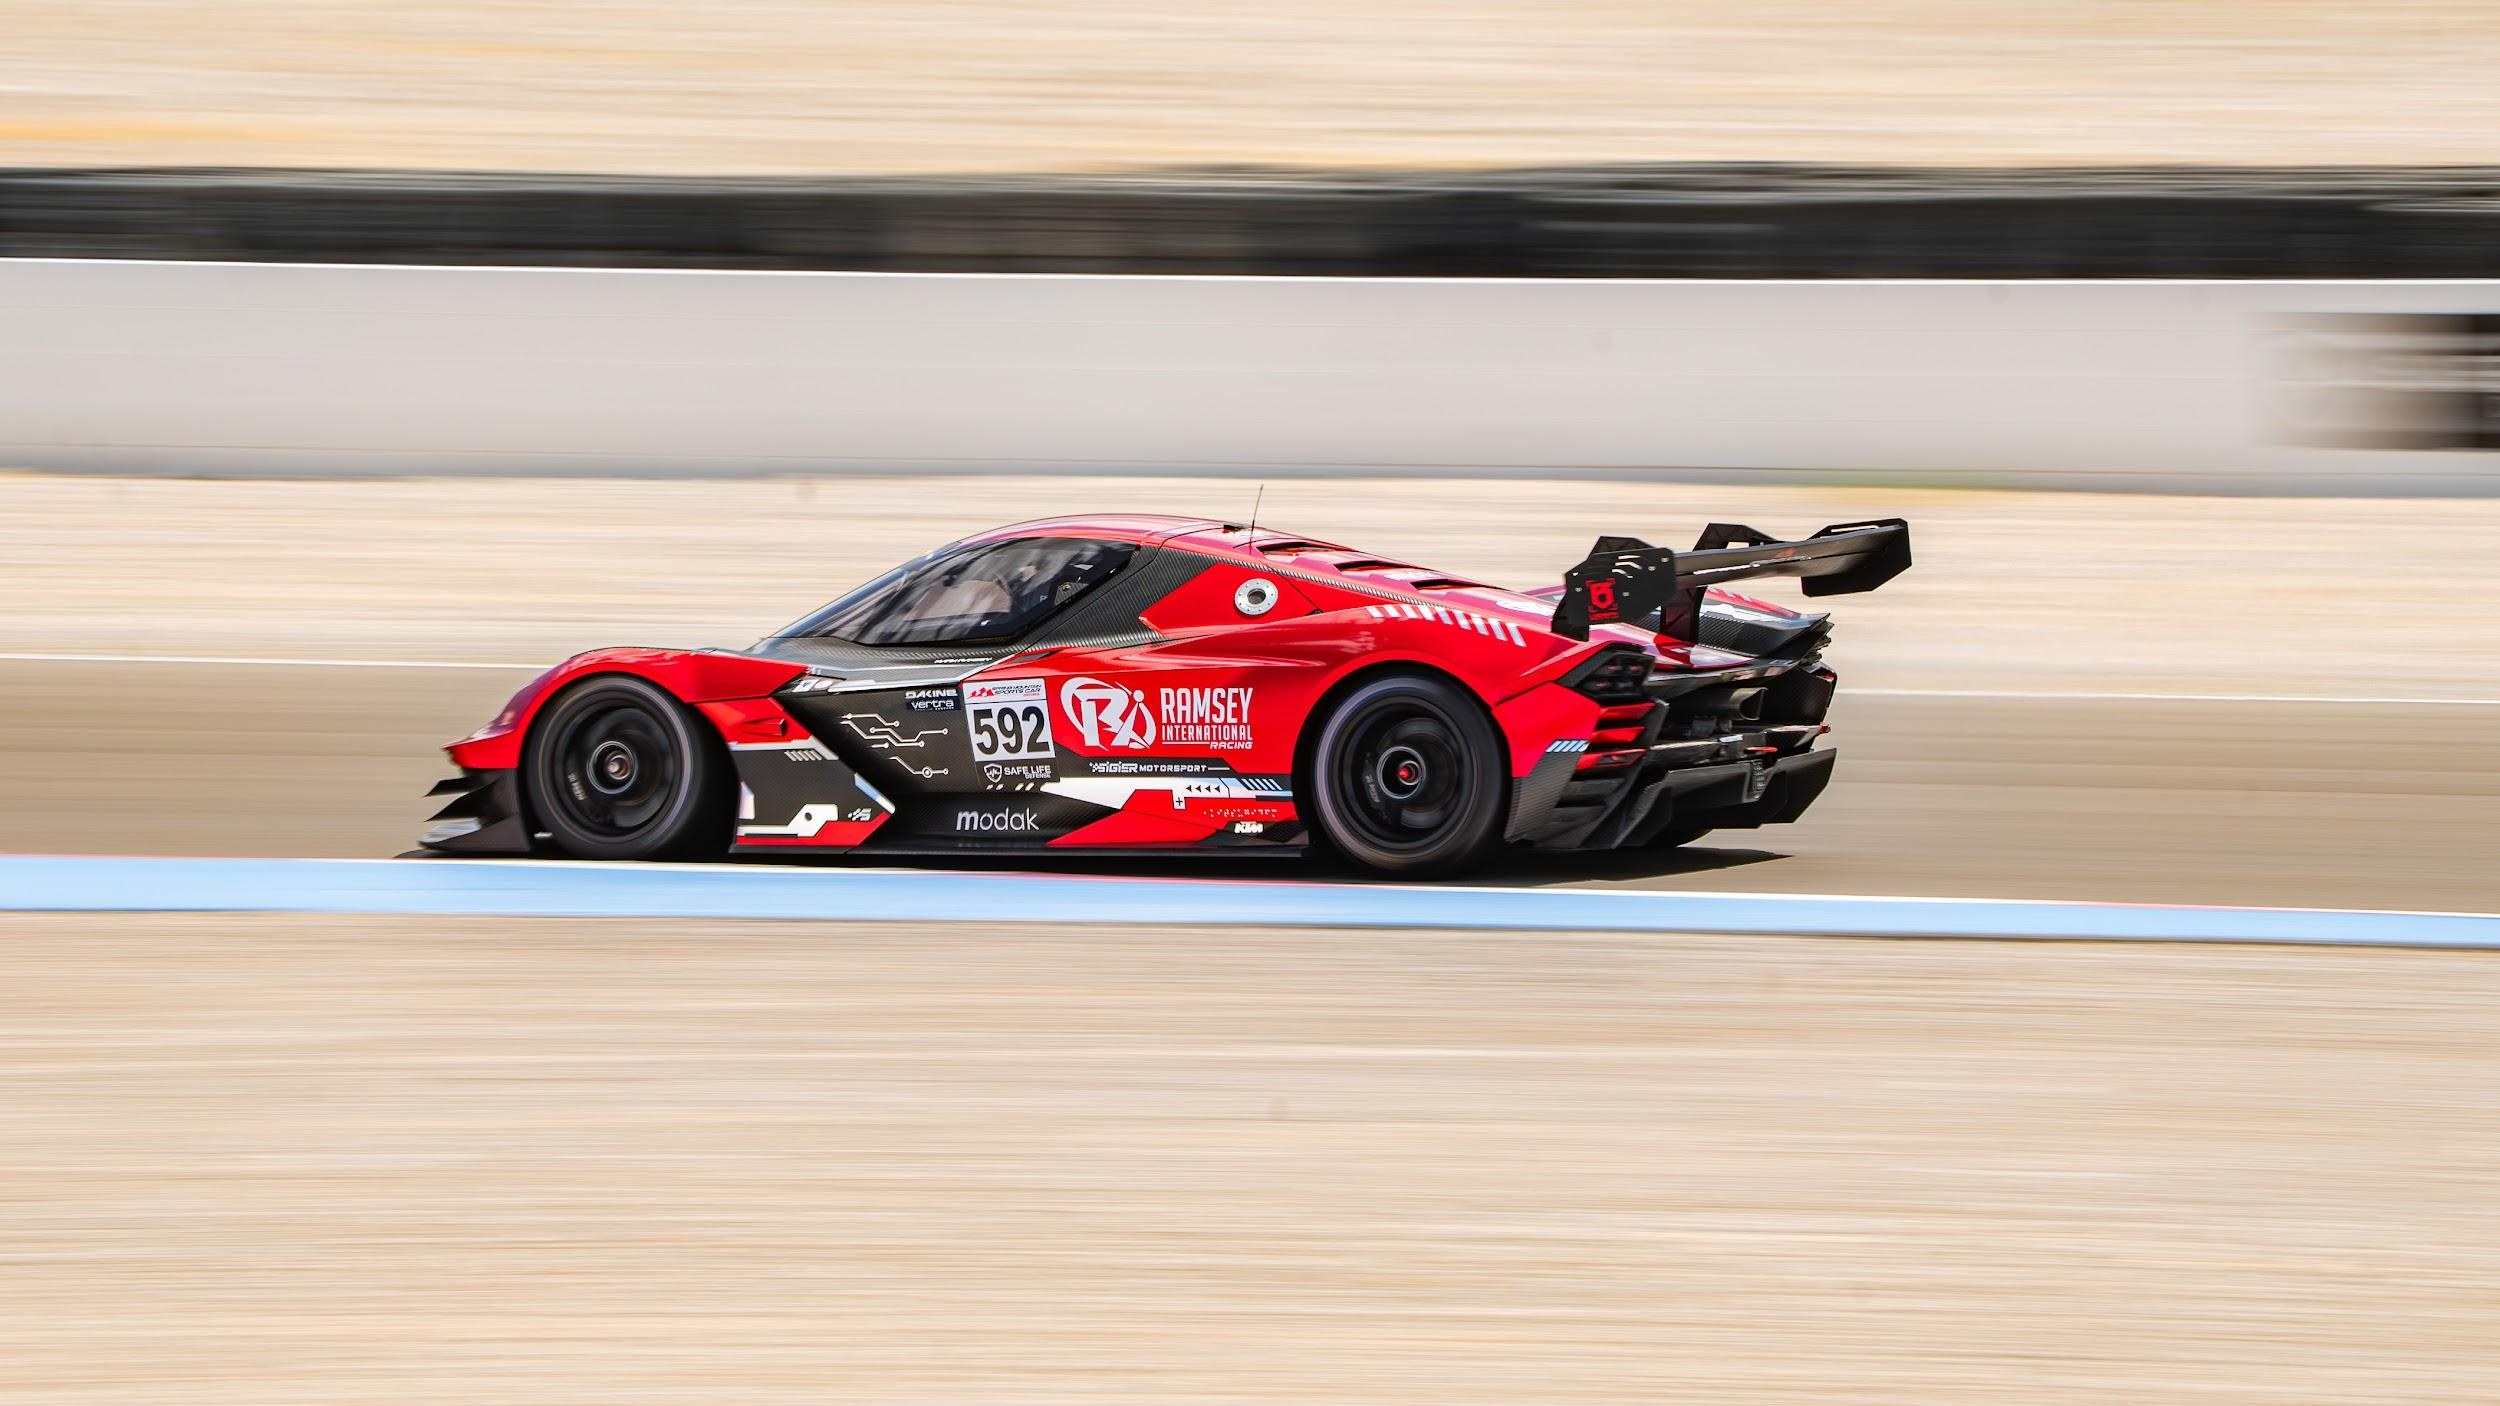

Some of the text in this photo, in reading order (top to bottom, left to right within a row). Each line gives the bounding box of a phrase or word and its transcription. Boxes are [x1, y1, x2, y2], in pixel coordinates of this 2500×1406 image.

[905, 689, 958, 699] DAKINE
[911, 700, 954, 709] vertra
[1160, 688, 1253, 724] RAMSEY
[973, 706, 1050, 755] 592
[1162, 725, 1253, 741] INTERNATIONAL
[1210, 741, 1253, 750] RACING
[1004, 765, 1051, 776] SAFE LIFE
[1139, 764, 1207, 772] MOTORSPORT
[956, 808, 1039, 831] modak
